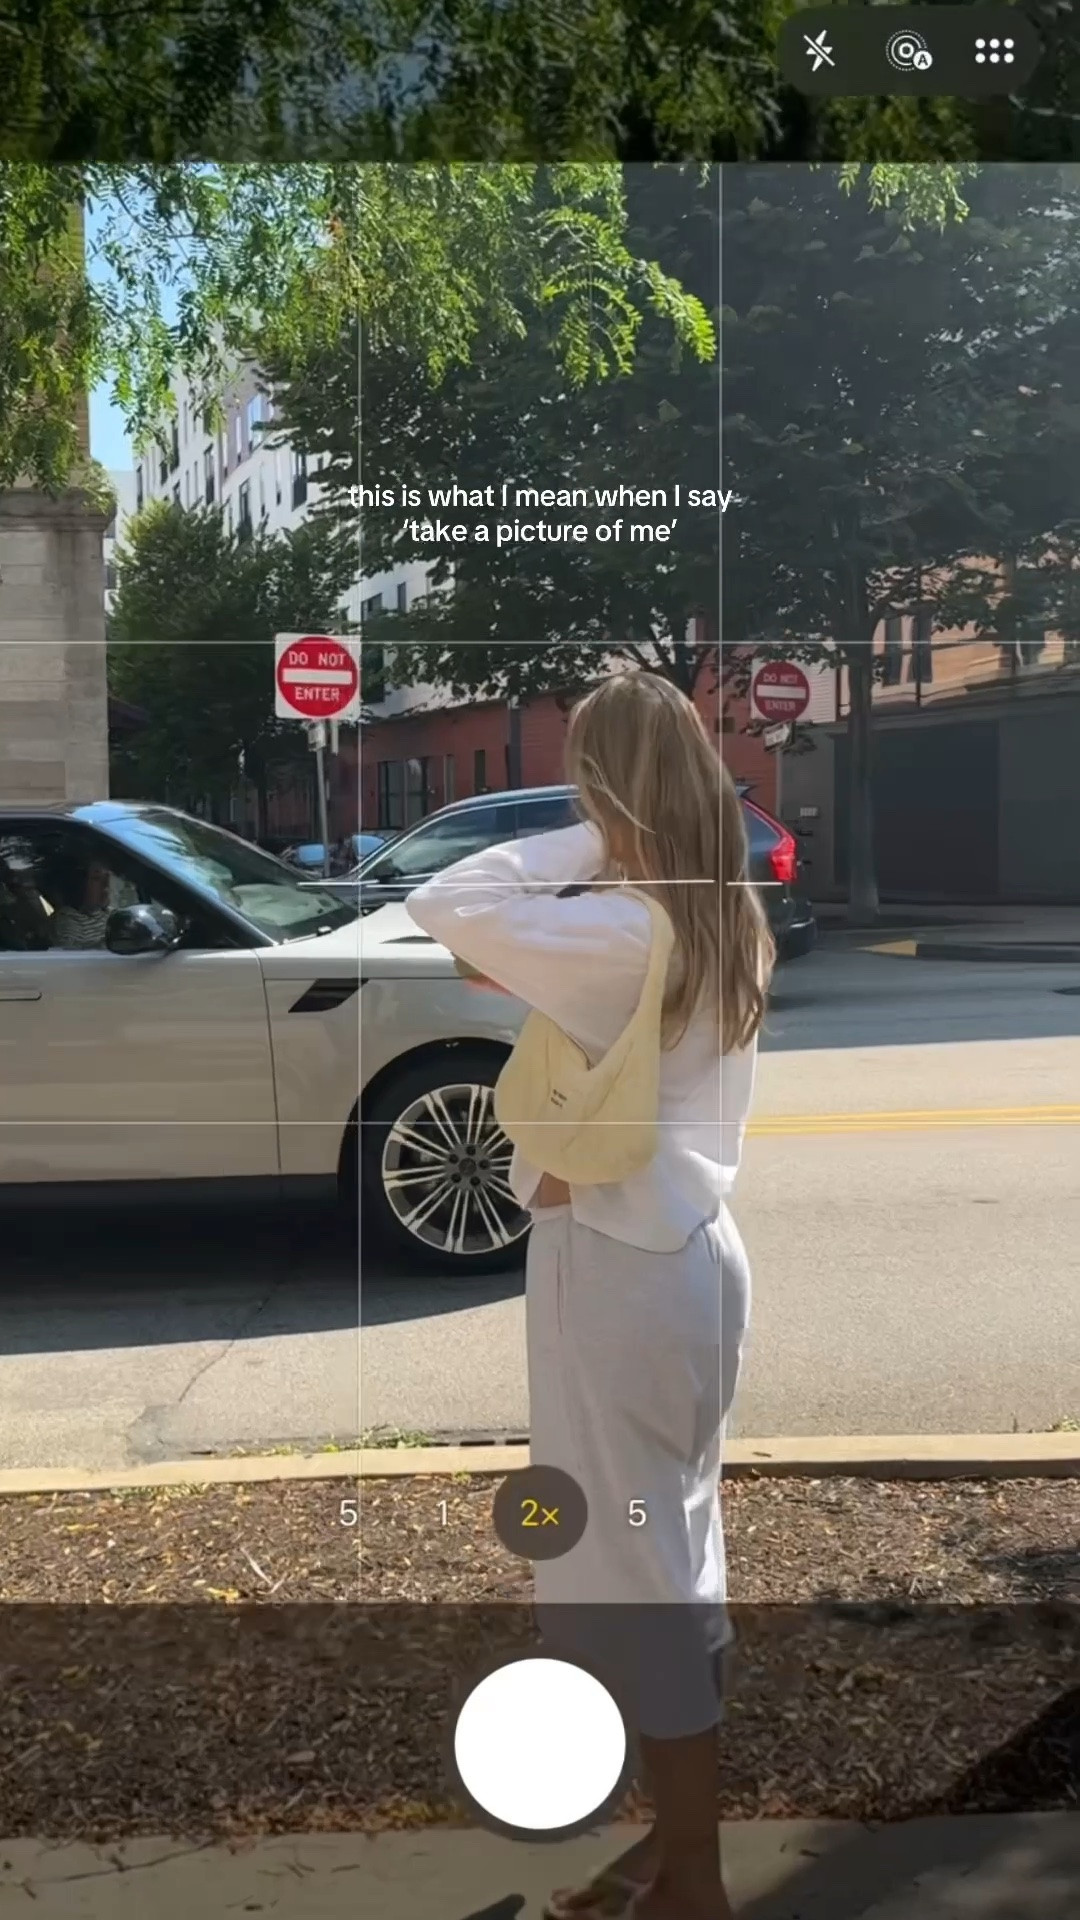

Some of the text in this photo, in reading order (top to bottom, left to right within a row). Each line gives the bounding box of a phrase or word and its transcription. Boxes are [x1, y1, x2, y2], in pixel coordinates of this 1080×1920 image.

[289, 651, 346, 667] DO NOT
[295, 687, 340, 701] ENTER
